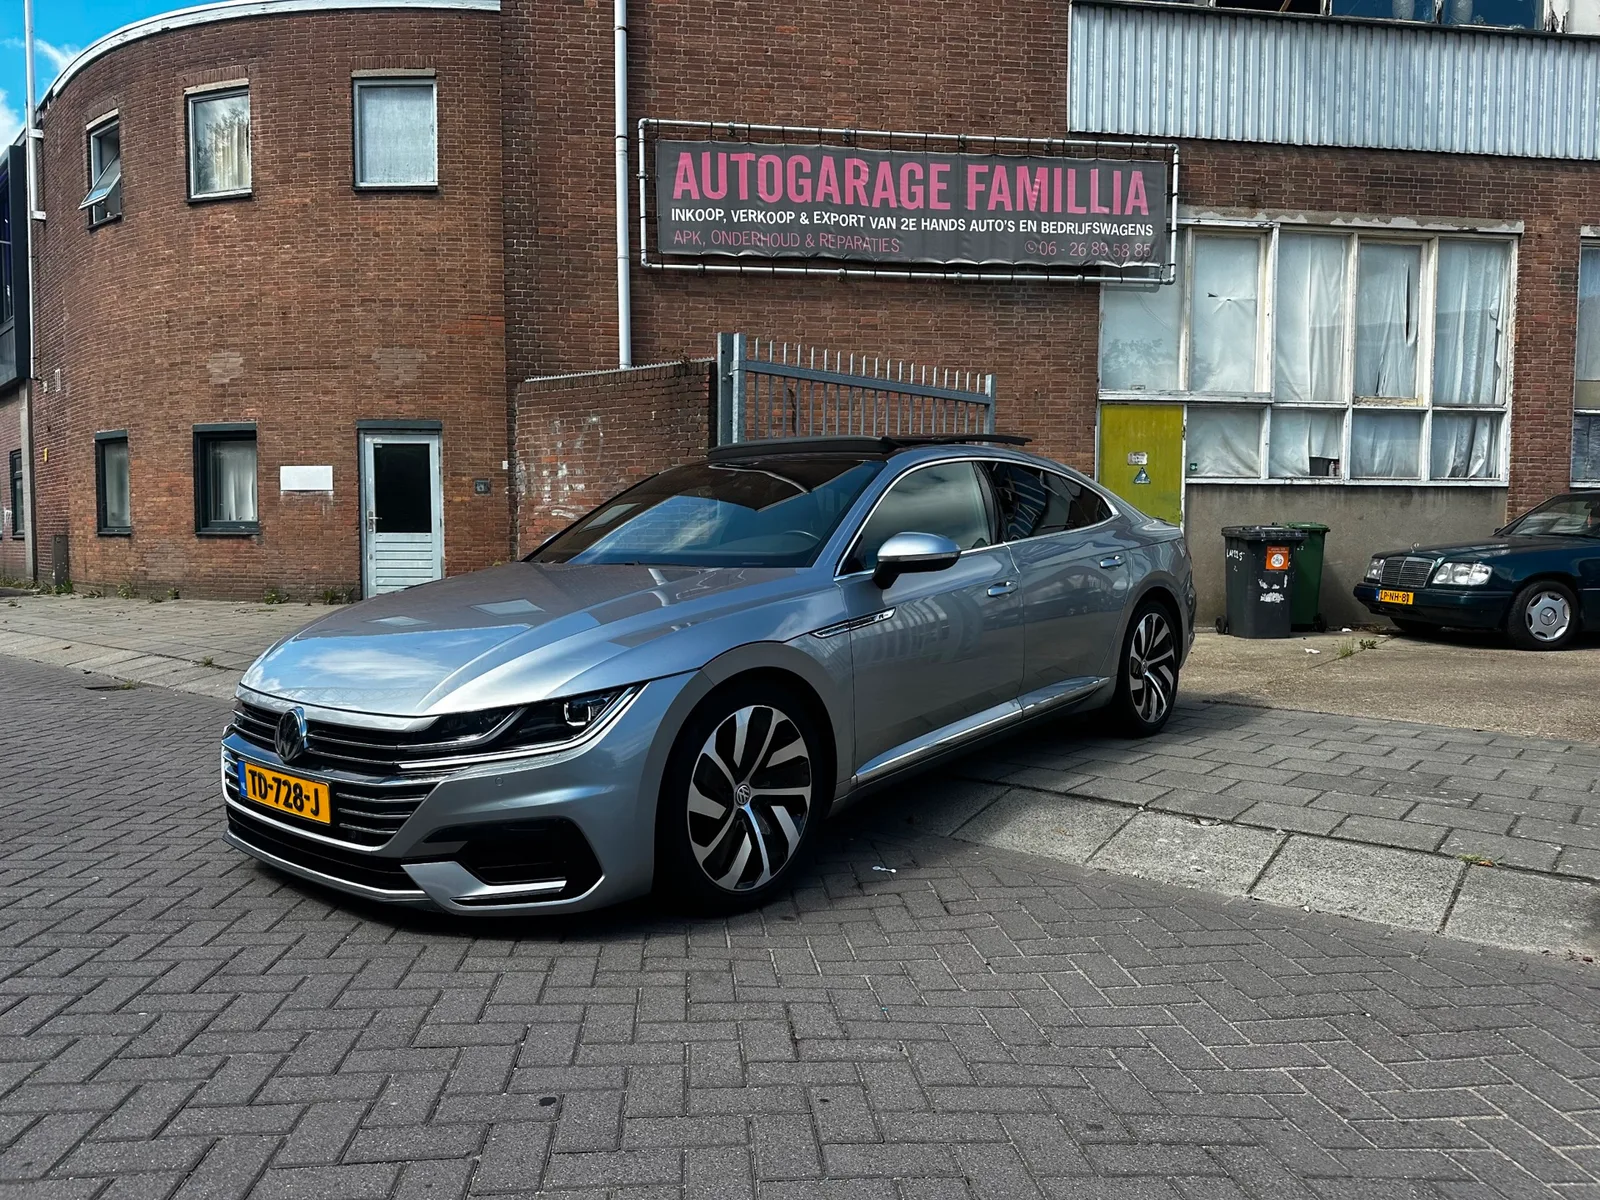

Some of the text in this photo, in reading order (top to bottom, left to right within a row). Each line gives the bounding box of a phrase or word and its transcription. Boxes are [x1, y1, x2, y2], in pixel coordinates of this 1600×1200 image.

[672, 151, 1149, 215] AUTOGARAGE FAMILLIA
[671, 207, 1153, 236] INKOOP, VERKOOP & EXPORT VAN 2E HANDS AUTO'S EN BEDRIJFSWAGENS
[673, 229, 900, 252] APK, ONDERHOUD & REPARATIES
[1039, 241, 1057, 256] 06
[1069, 242, 1087, 257] 26
[1091, 242, 1109, 258] 89
[1113, 243, 1130, 258] 58
[1134, 243, 1151, 258] 85
[248, 769, 320, 817] TD-728-J
